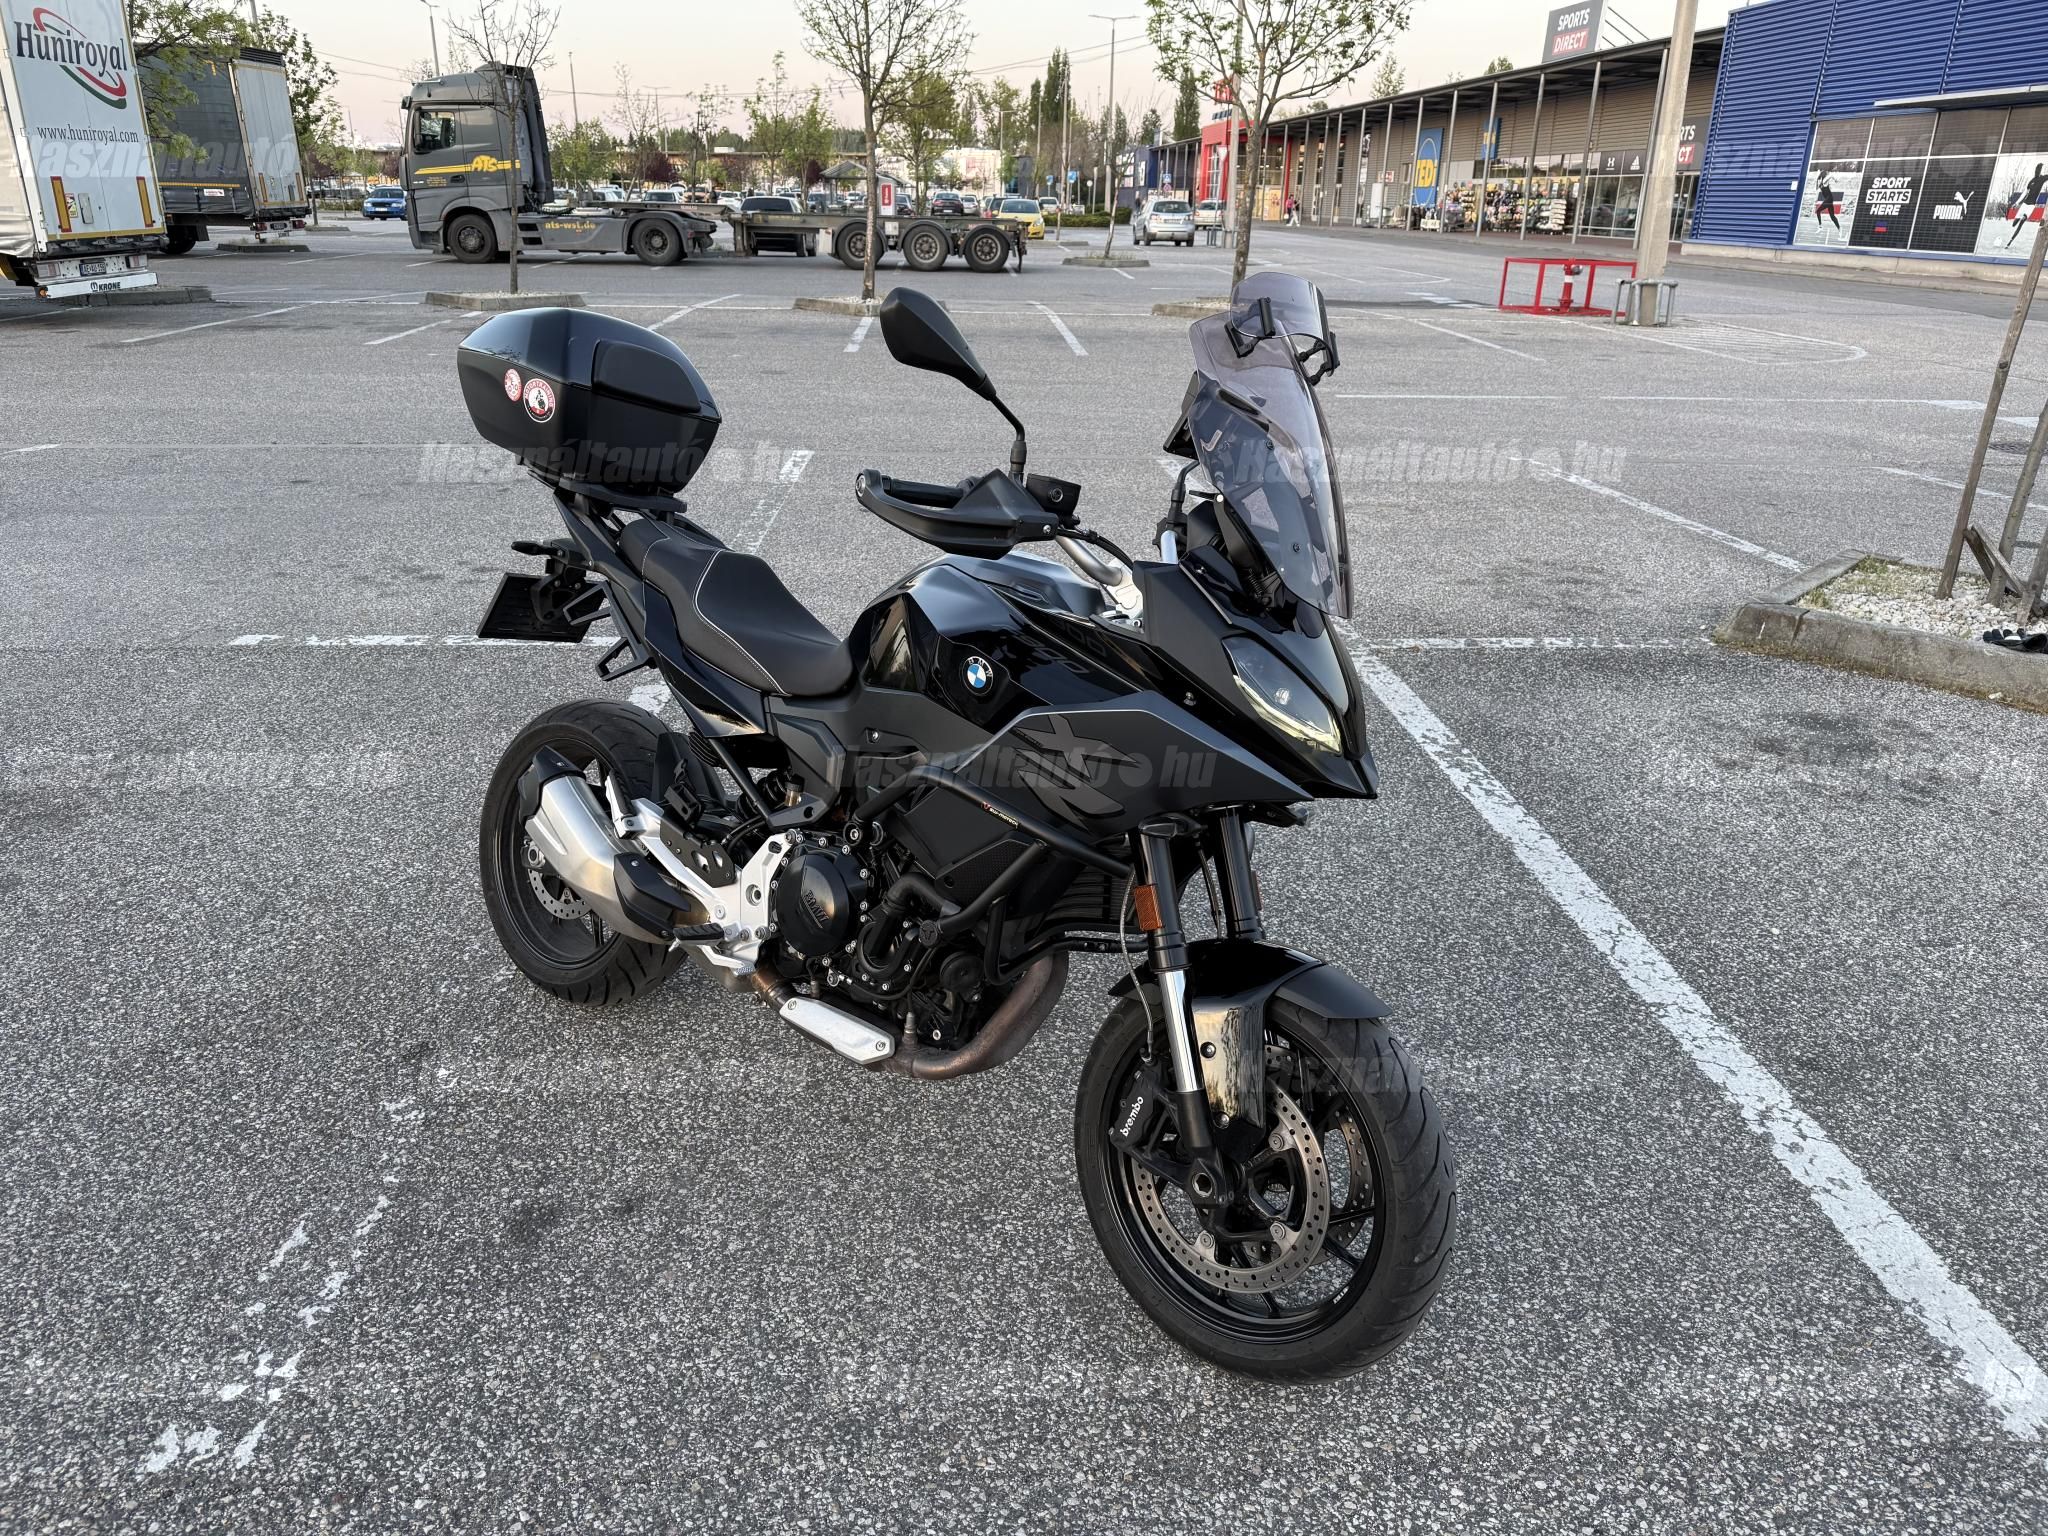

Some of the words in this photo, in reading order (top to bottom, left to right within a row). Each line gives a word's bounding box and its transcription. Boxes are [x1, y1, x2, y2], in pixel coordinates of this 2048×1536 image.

[1557, 8, 1591, 31] SPORTS
[14, 21, 127, 77] Huniroyal
[1553, 31, 1587, 53] DIRECT
[36, 123, 139, 146] www.huniroyal.com
[471, 155, 498, 173] ATS
[1871, 176, 1912, 189] SPORT
[1867, 190, 1910, 201] STARTS
[1869, 204, 1902, 216] HERE
[1932, 204, 1963, 220] PUMA
[98, 281, 121, 292] KRONE
[968, 657, 993, 678] BMW
[1120, 1096, 1144, 1137] brembo
